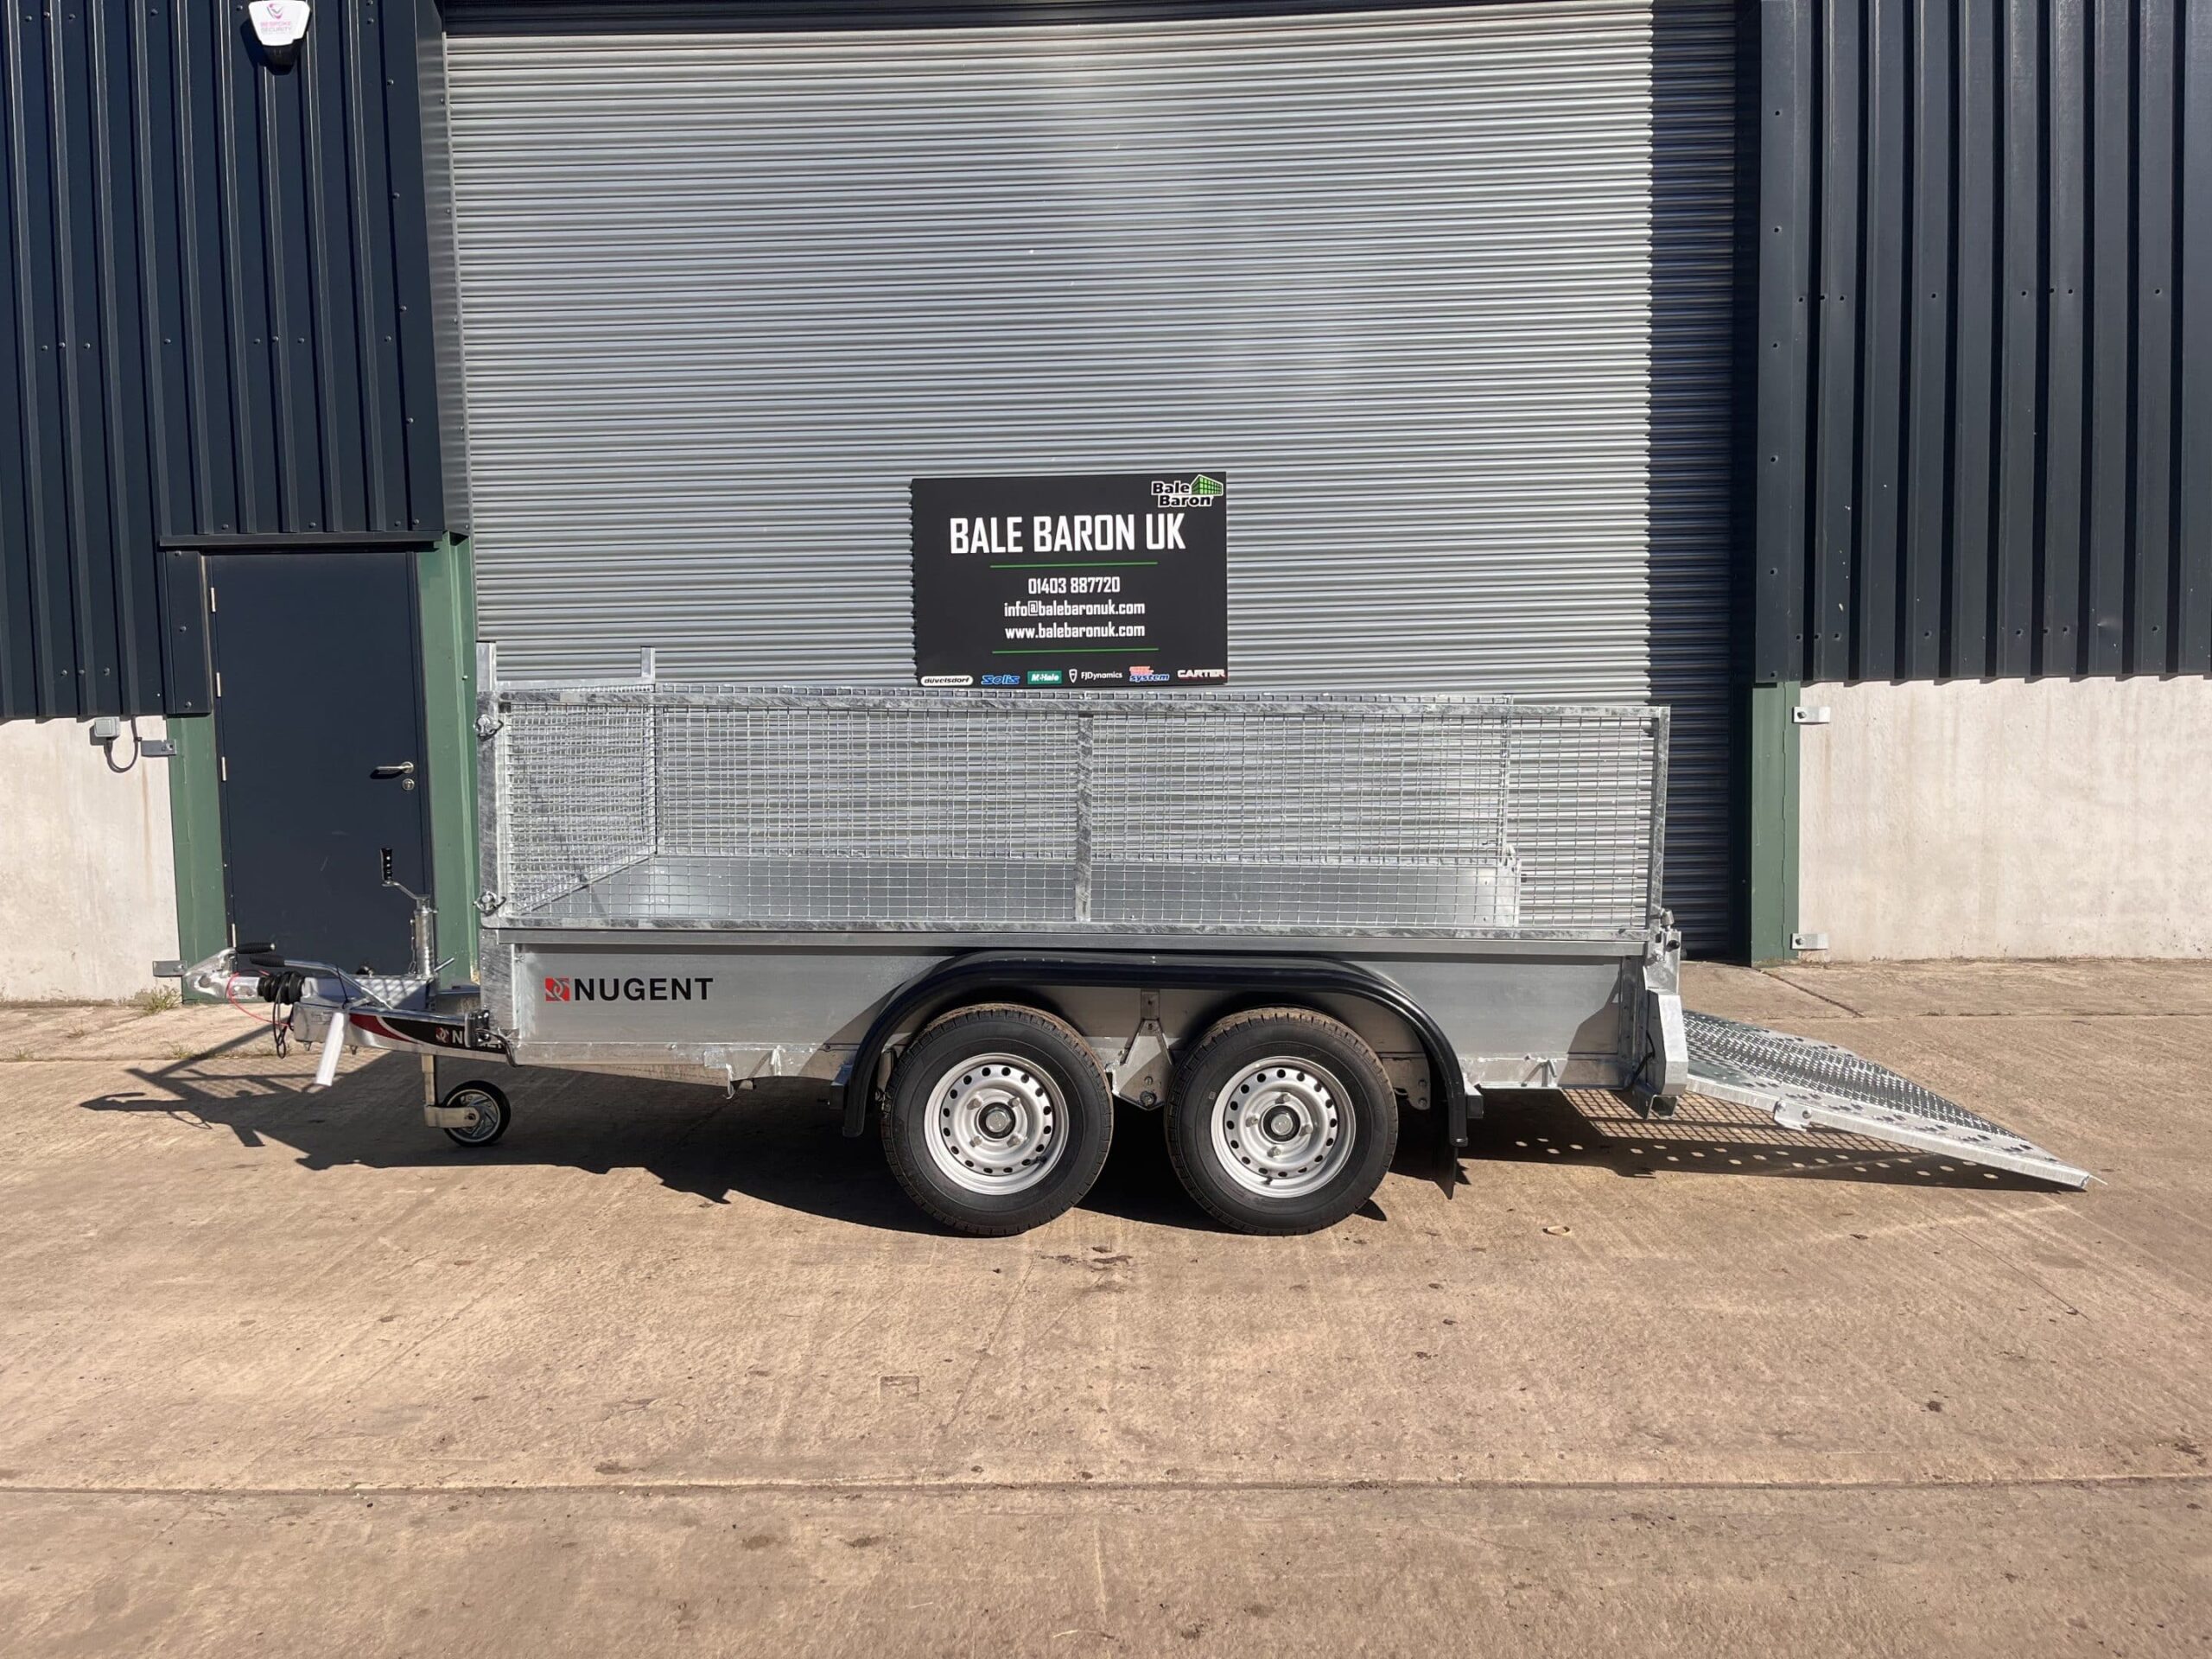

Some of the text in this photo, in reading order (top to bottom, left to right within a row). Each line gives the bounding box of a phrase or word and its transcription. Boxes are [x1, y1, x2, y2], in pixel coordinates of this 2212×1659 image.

[1152, 481, 1191, 495] Bale
[1159, 495, 1211, 507] Baron
[950, 513, 1186, 554] BALE BARON UK
[1028, 576, 1121, 594] 01403 887720
[1004, 600, 1146, 617] info@balebaronuk.com
[1005, 621, 1146, 639] www.balebaronuk.com
[1081, 671, 1123, 681] FJDynamics
[1129, 673, 1170, 683] system
[1177, 669, 1225, 677] CARTER
[574, 977, 714, 1001] NUGENT
